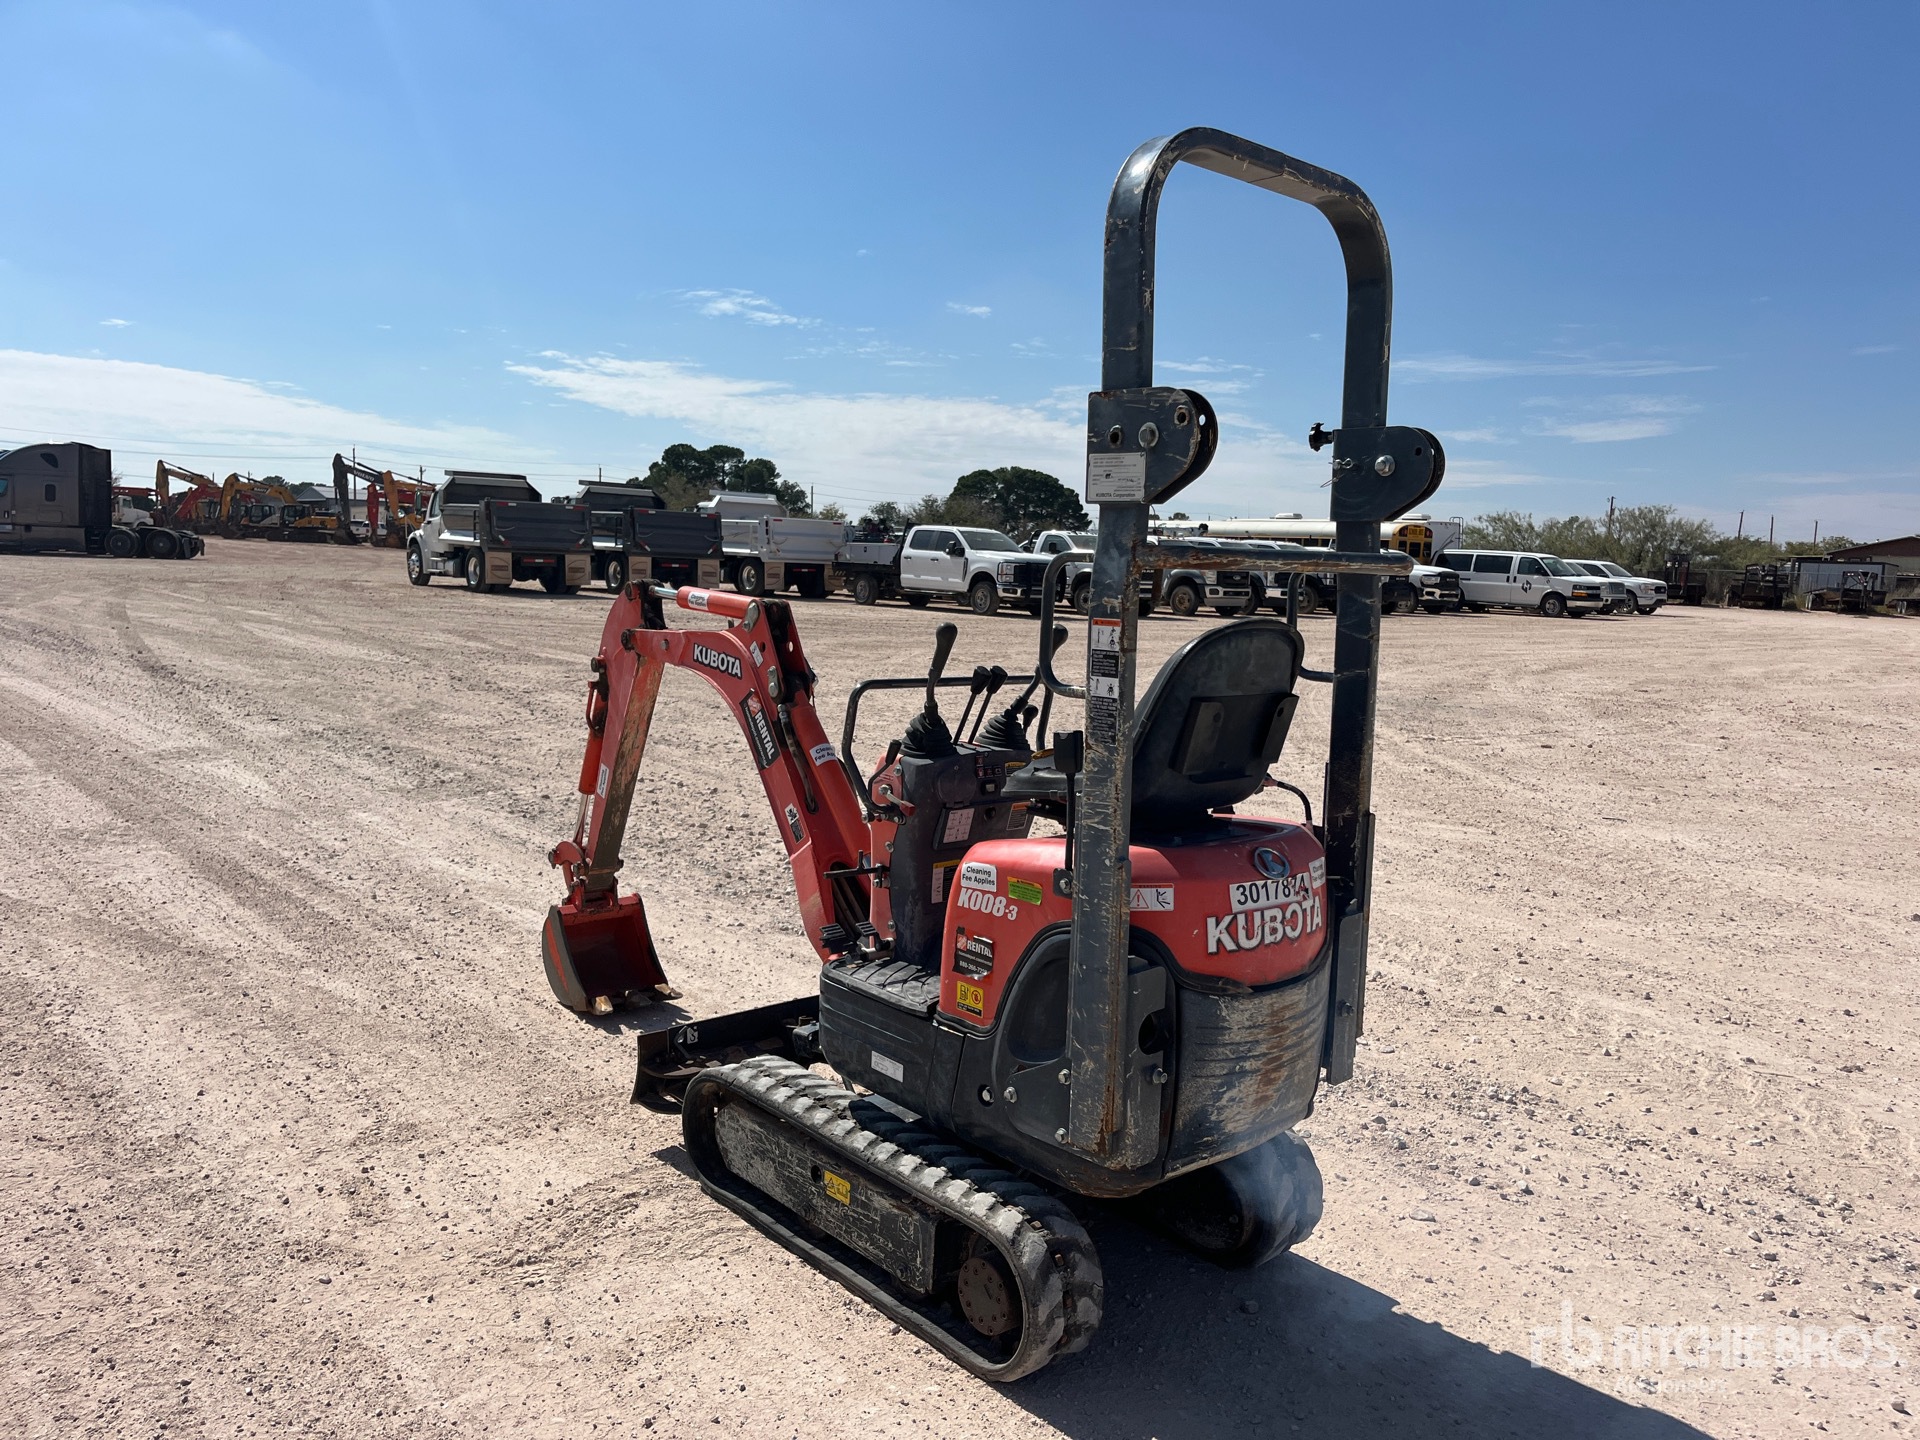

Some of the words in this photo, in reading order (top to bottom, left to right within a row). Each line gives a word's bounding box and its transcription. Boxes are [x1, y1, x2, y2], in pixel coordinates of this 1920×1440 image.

[353, 470, 375, 481] VOLVO
[693, 643, 742, 678] KUBOTA
[755, 711, 775, 760] RENTAL
[962, 873, 973, 882] Fee
[973, 877, 995, 886] Applies
[966, 866, 992, 878] Cleaning
[957, 887, 1018, 921] K008-3
[1206, 895, 1323, 955] KUBOTA
[966, 940, 993, 958] RENTAL
